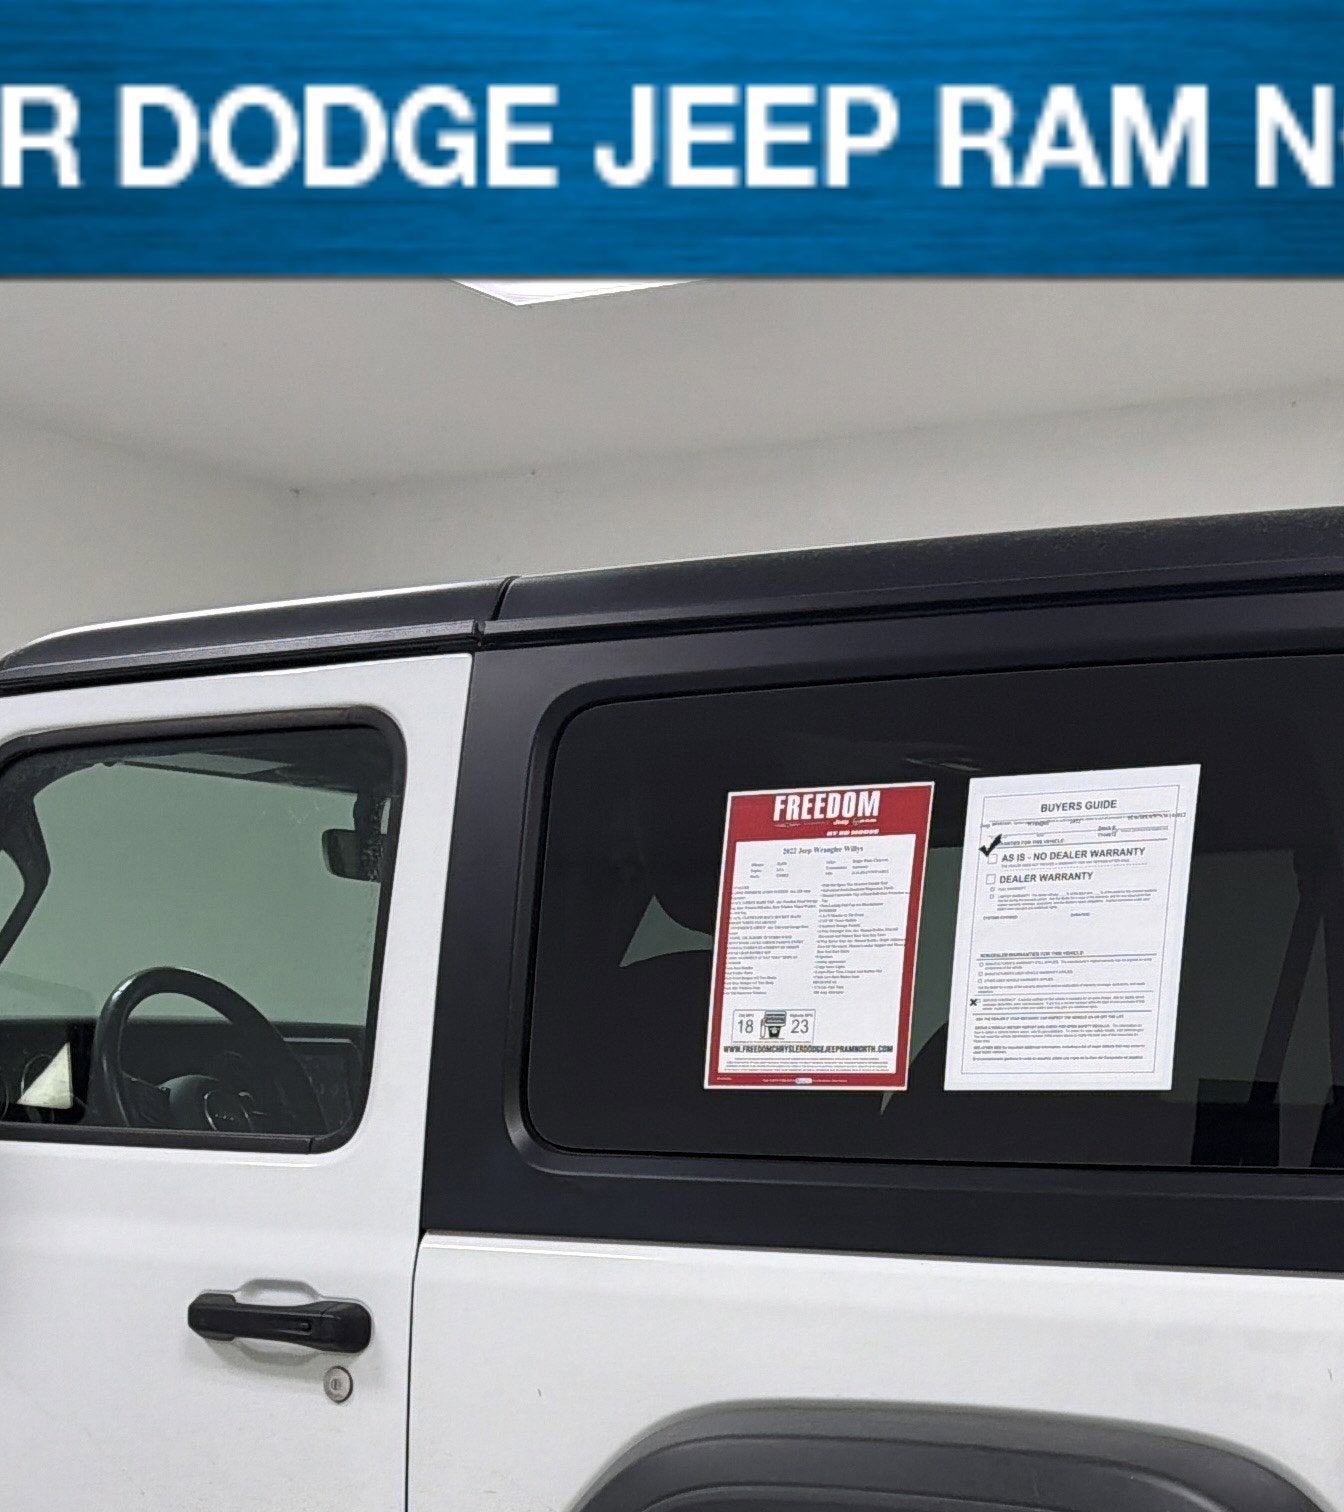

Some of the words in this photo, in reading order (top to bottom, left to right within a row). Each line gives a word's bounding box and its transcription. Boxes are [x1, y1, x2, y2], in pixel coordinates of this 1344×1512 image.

[773, 791, 881, 821] FREEDOM
[1040, 801, 1082, 813] BUYERS
[1084, 799, 1118, 811] GUIDE
[1001, 853, 1014, 863] AS
[1016, 852, 1025, 862] IS
[1033, 851, 1048, 862] NO
[1049, 849, 1088, 860] DEALER
[1089, 847, 1146, 859] WARRANTY
[999, 874, 1037, 884] DEALER
[1038, 871, 1094, 883] WARRANTY
[737, 1019, 754, 1034] 18
[790, 1019, 809, 1034] 23
